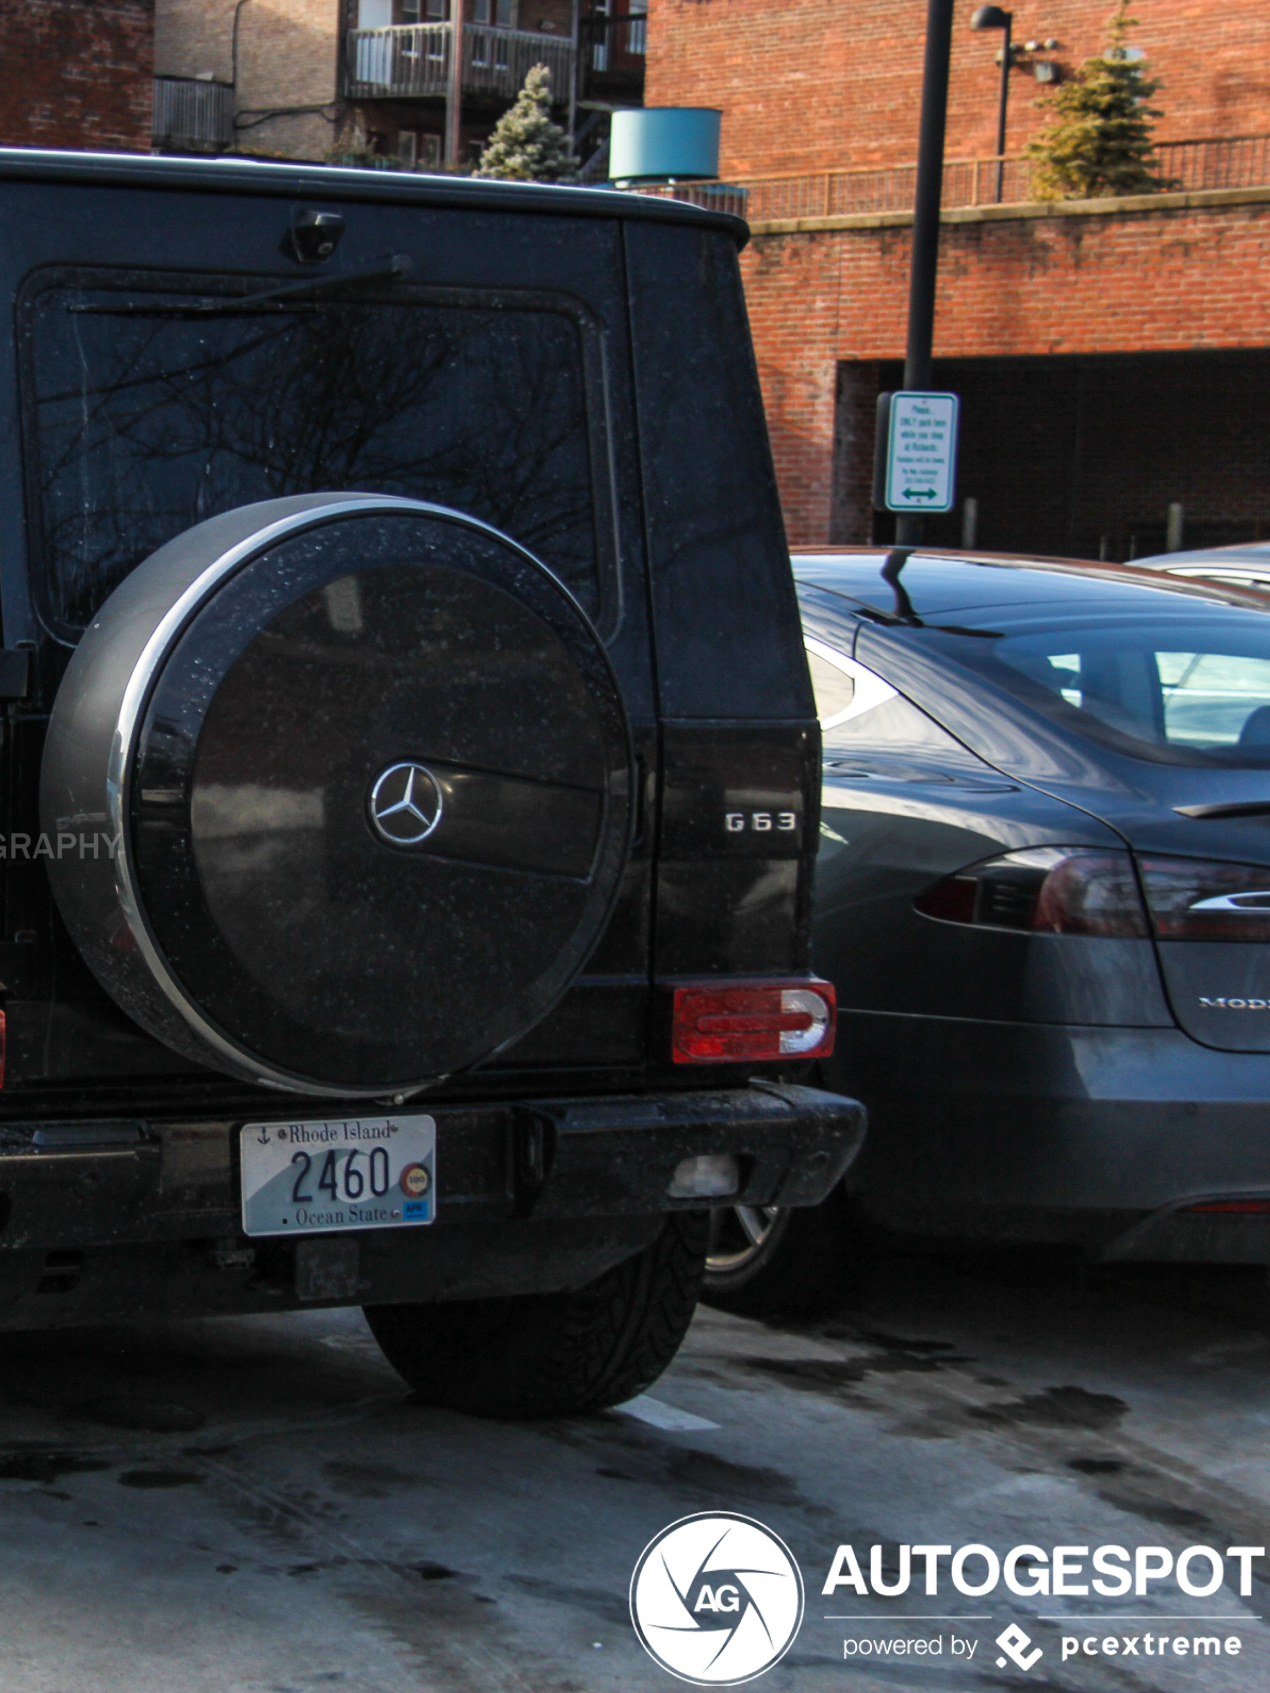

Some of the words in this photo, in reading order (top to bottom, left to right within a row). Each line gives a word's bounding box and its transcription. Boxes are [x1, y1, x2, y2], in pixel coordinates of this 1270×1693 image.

[1198, 997, 1270, 1010] MOD
[288, 1124, 338, 1144] Rhode
[343, 1120, 392, 1141] Island
[291, 1146, 390, 1203] 2460
[295, 1207, 344, 1226] Ocean
[348, 1204, 388, 1223] State
